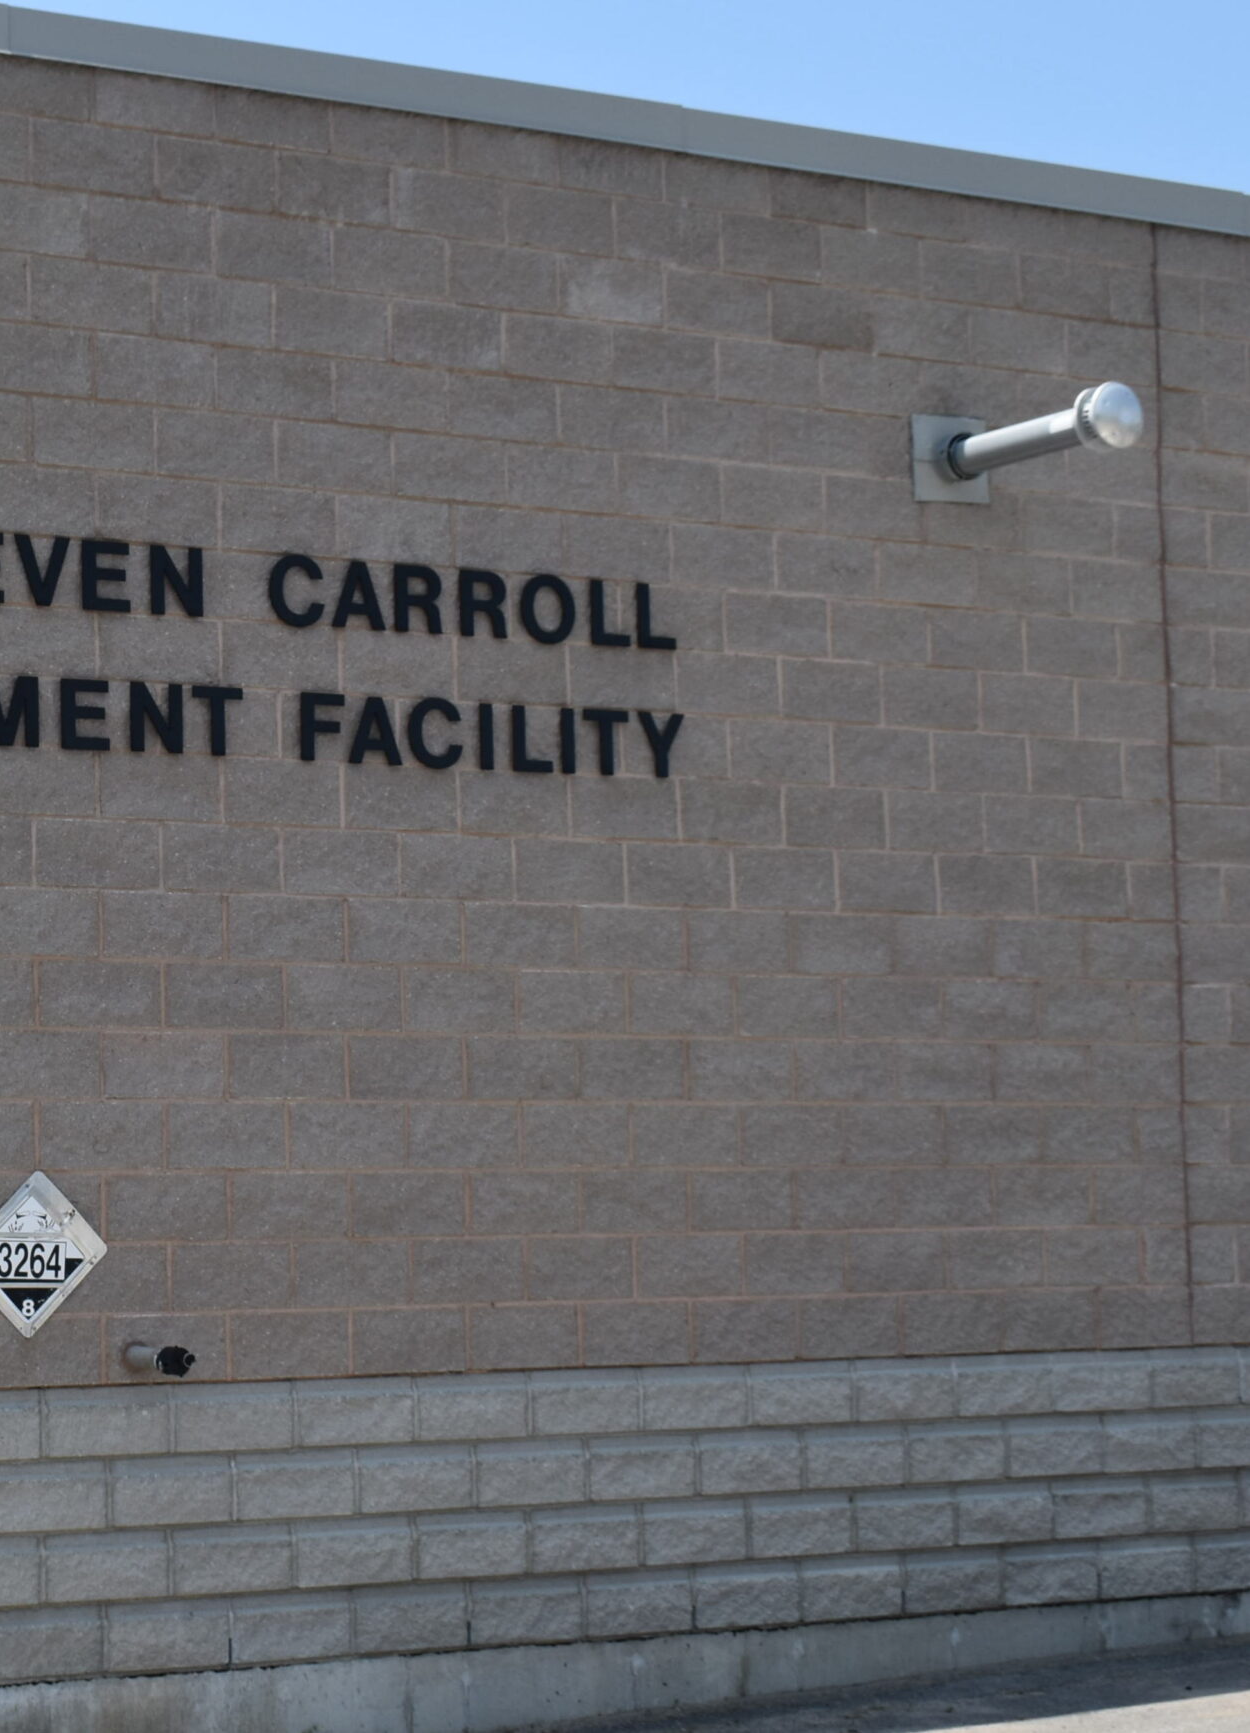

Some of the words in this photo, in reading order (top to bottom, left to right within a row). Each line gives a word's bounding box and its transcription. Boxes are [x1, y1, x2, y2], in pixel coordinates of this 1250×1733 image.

[267, 551, 678, 652] CARROLL
[297, 692, 684, 780] FACILITY
[21, 1299, 35, 1317] 8
